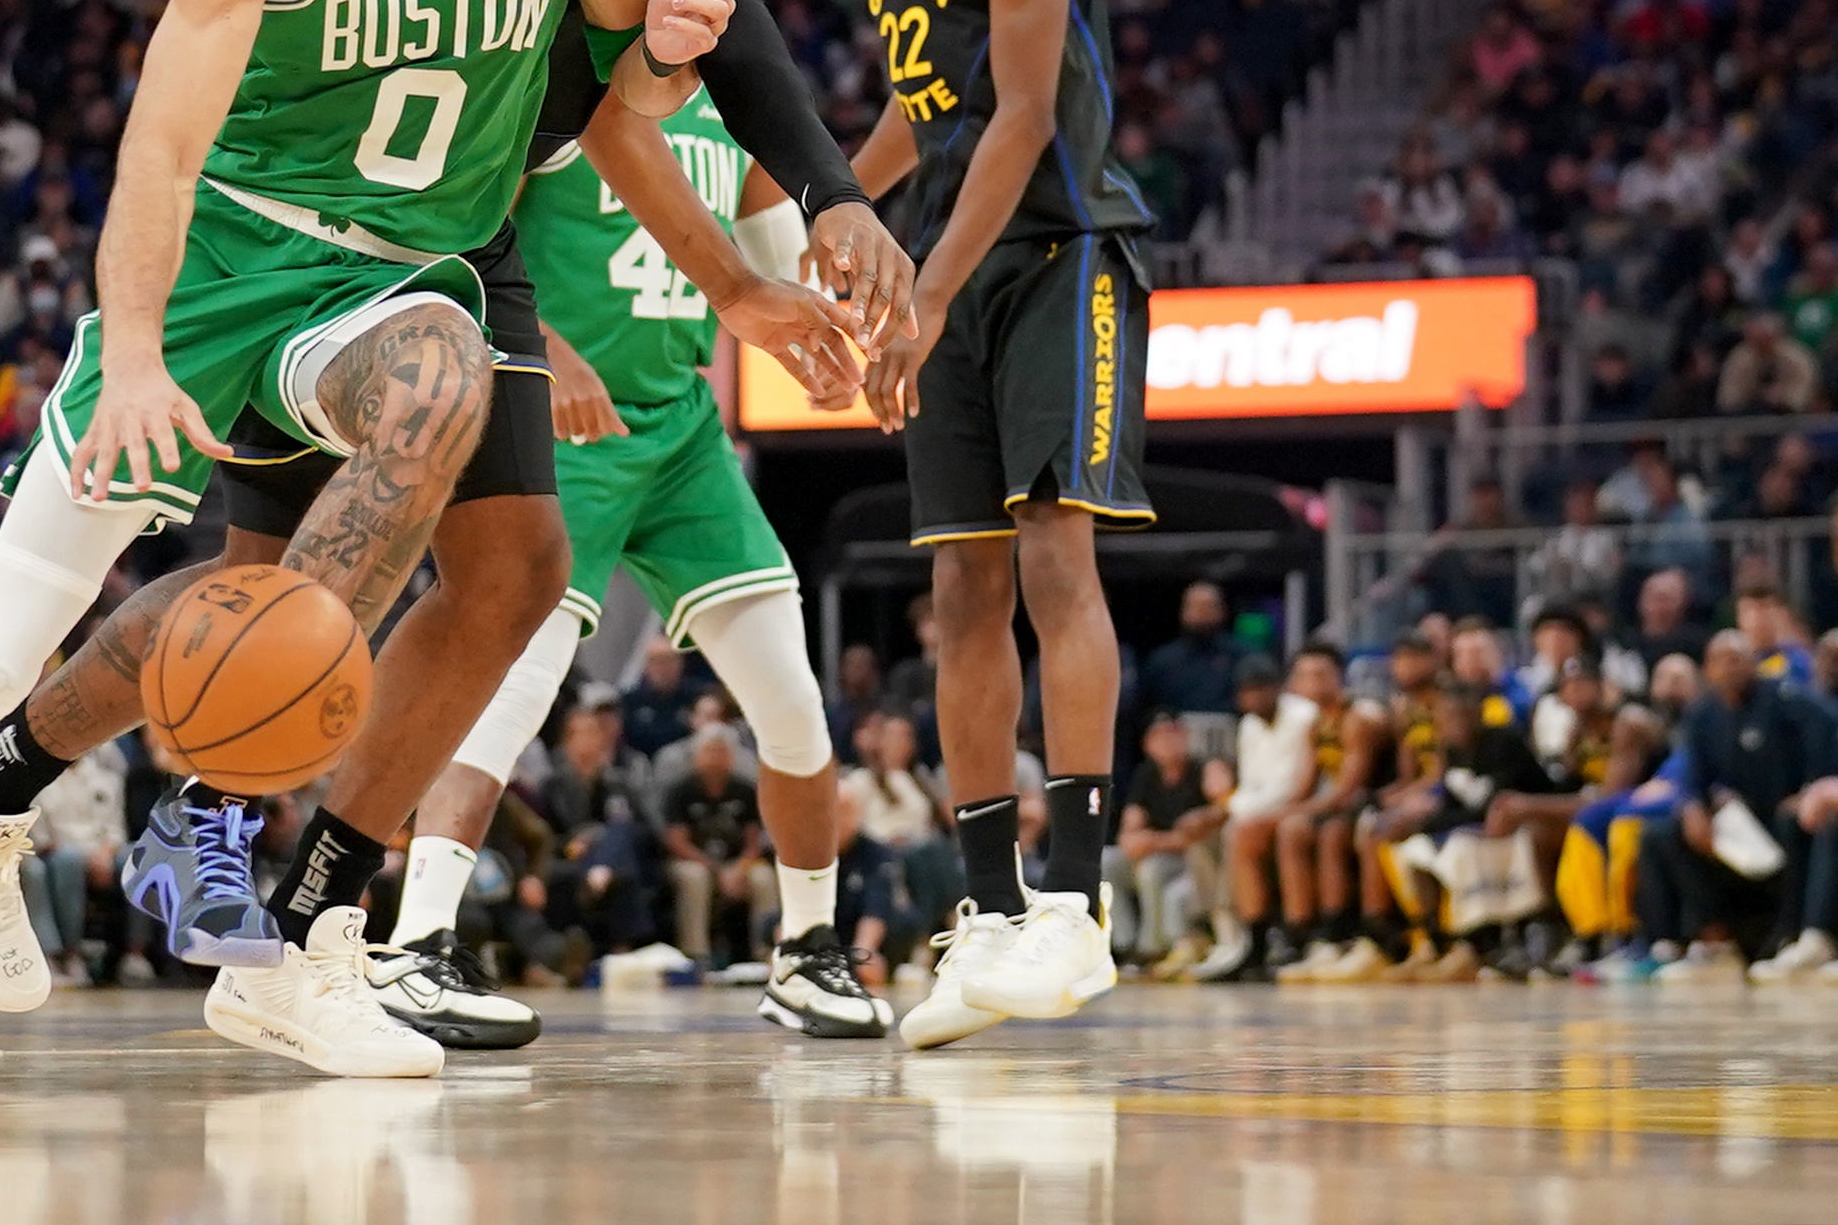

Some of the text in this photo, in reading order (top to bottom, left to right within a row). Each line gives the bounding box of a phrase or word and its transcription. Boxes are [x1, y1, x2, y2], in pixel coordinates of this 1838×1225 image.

[879, 5, 933, 84] 22
[353, 67, 469, 192] 0
[1088, 273, 1117, 465] WARRIORS
[1145, 298, 1419, 390] entral
